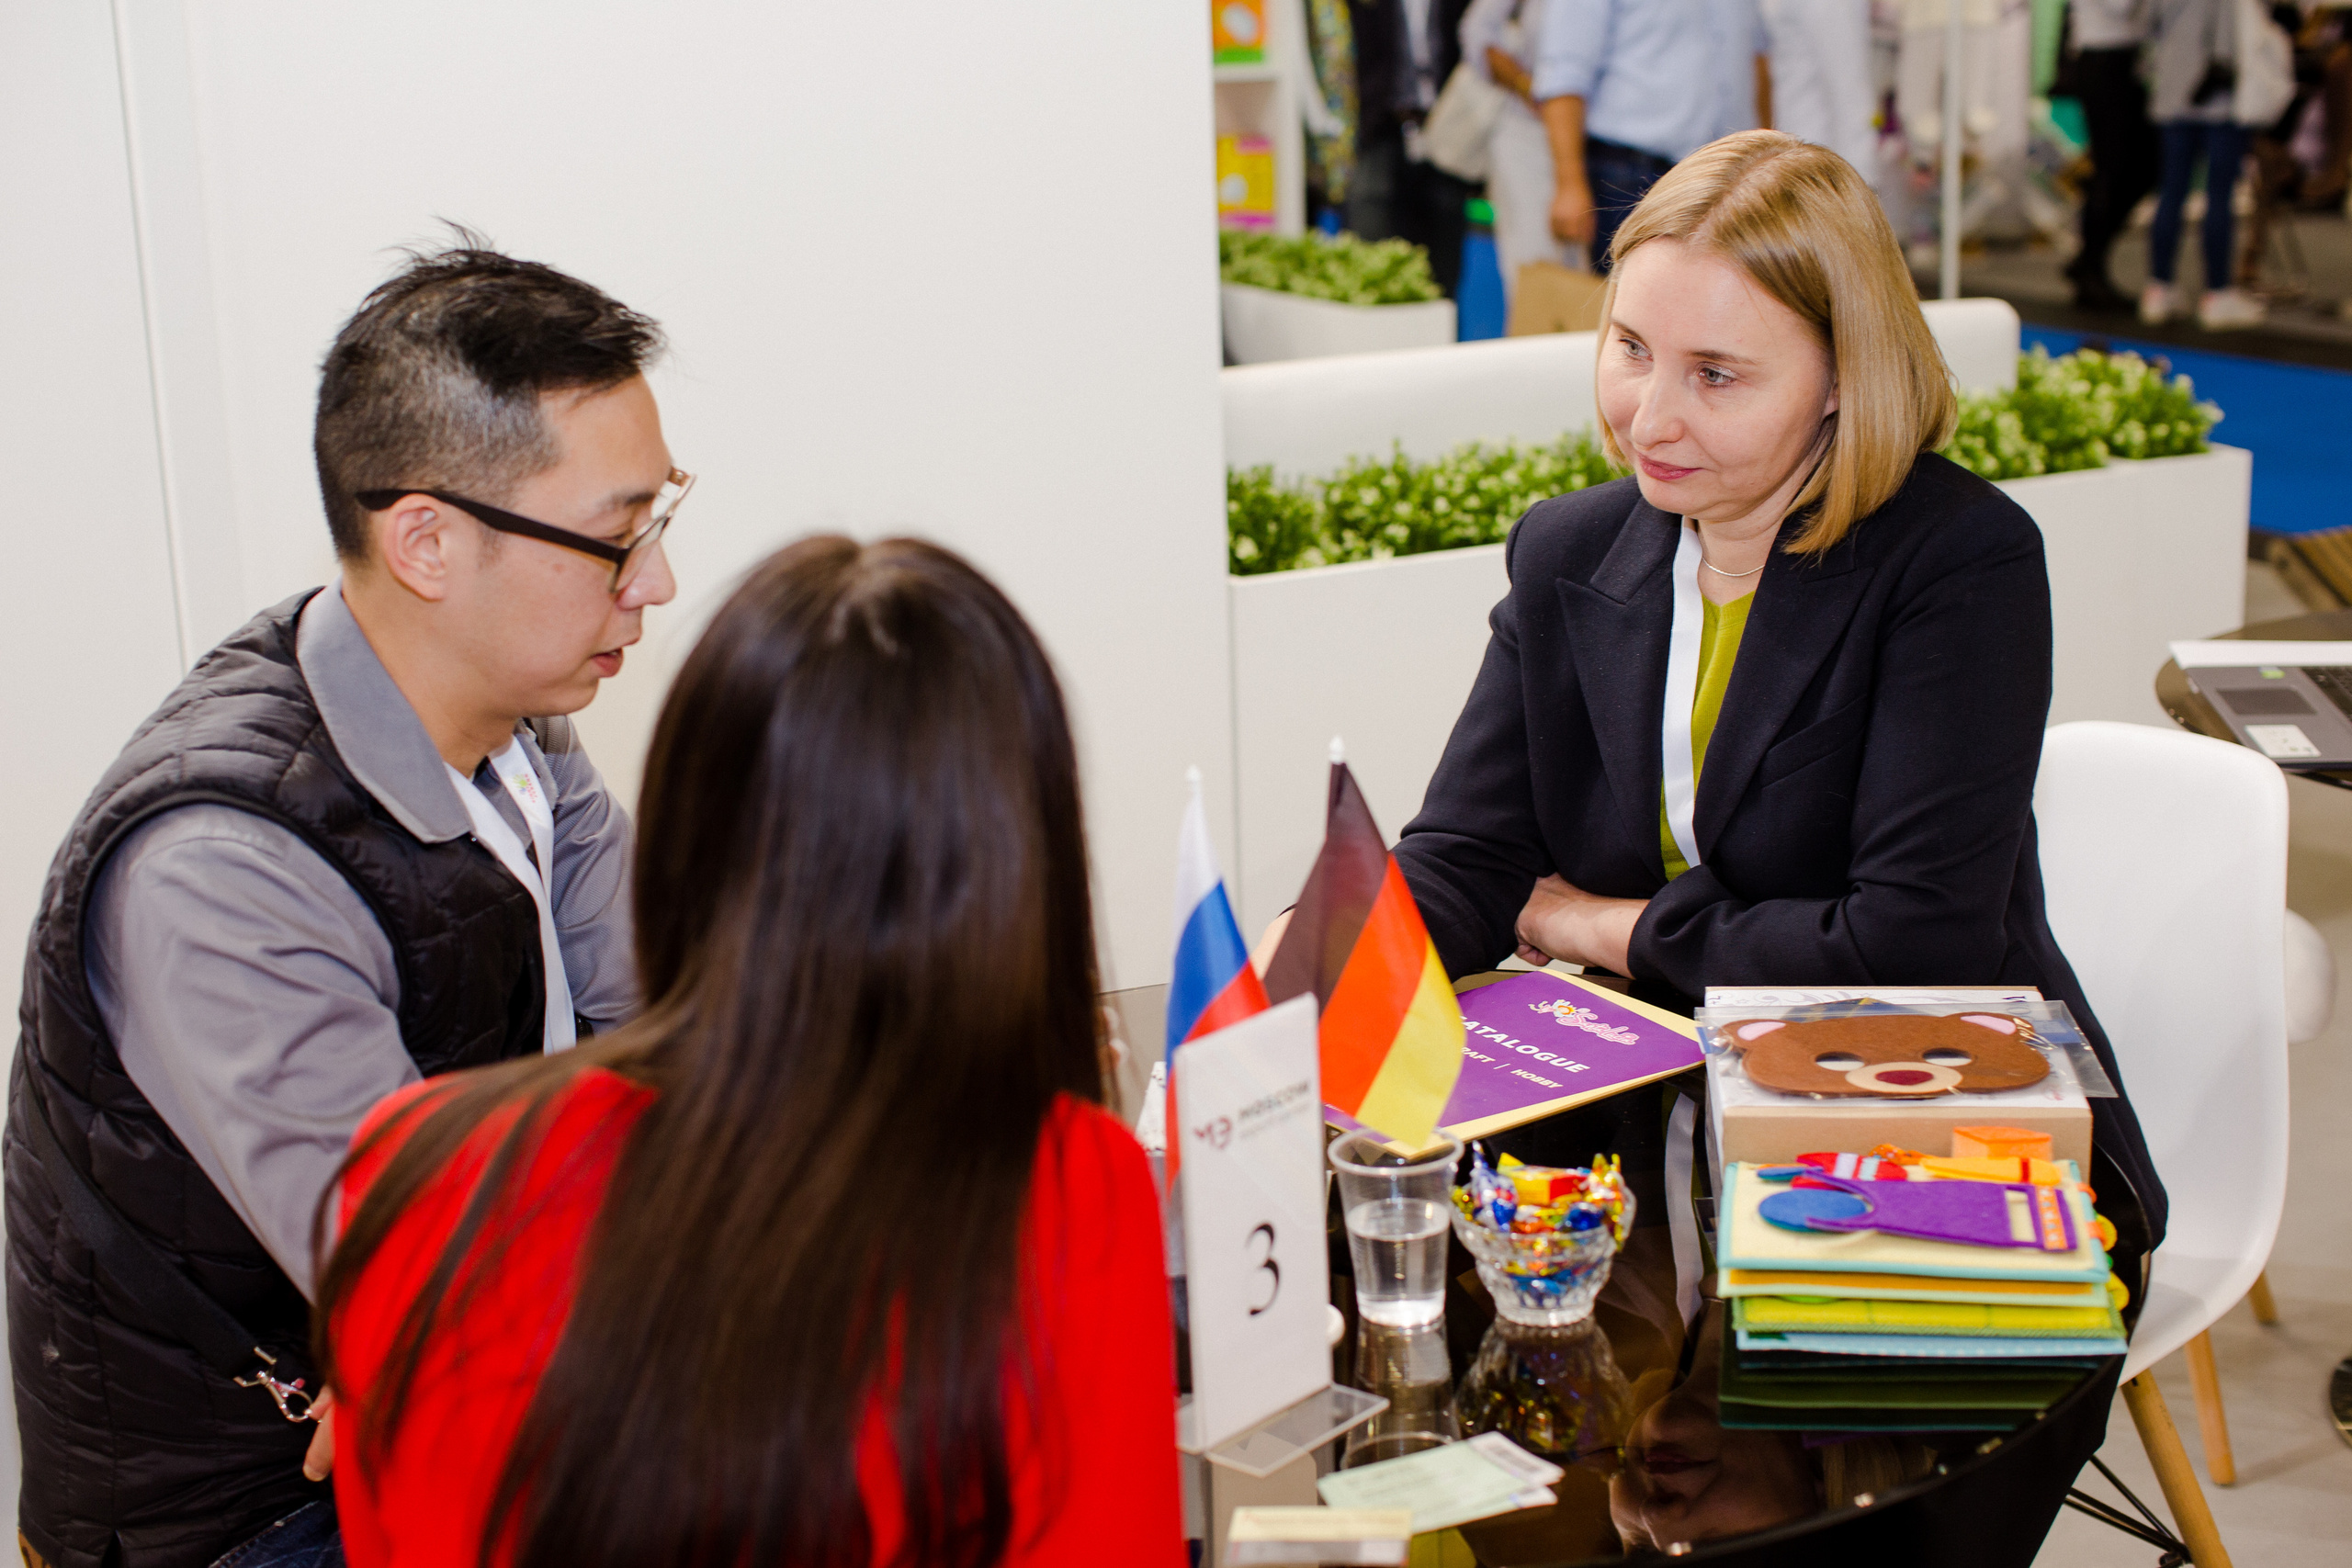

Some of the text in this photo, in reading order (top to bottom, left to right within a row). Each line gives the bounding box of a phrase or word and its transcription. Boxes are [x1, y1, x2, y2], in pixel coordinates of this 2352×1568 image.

[1460, 1015, 1591, 1073] ATALOGUE
[1461, 1046, 1496, 1063] RAFT
[1510, 1068, 1564, 1089] HOBBY
[1244, 1222, 1280, 1316] 3
